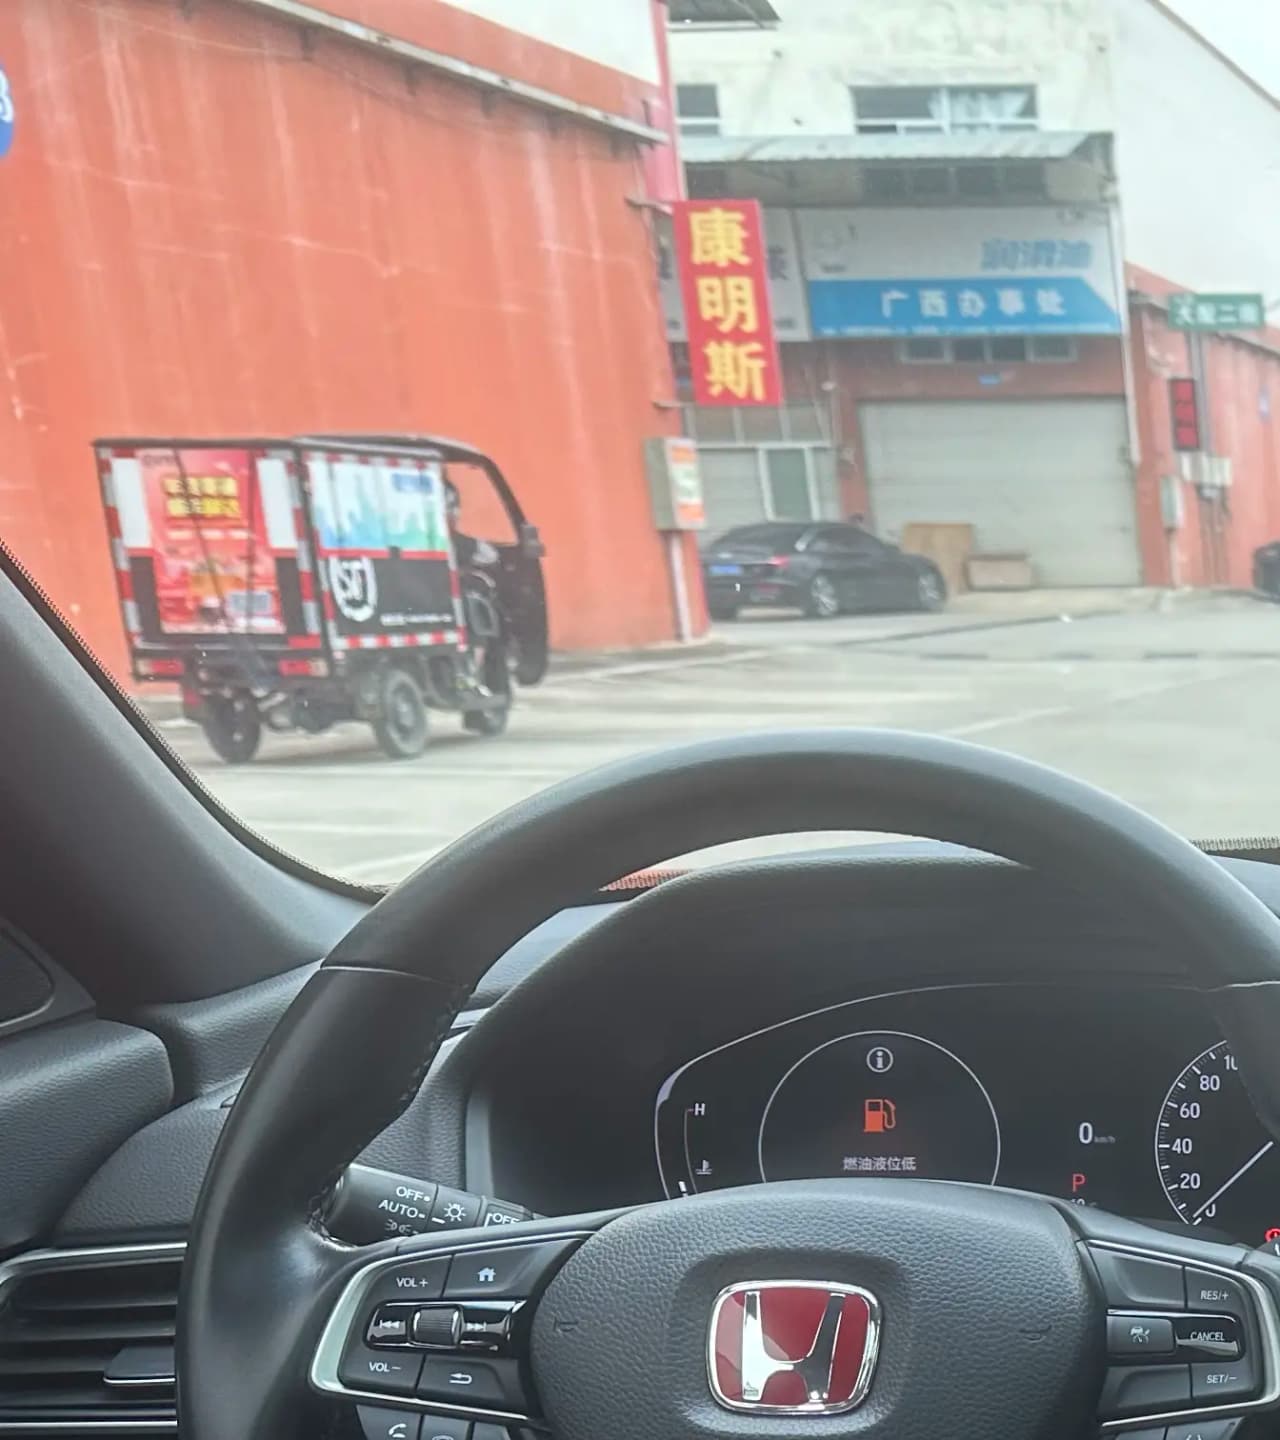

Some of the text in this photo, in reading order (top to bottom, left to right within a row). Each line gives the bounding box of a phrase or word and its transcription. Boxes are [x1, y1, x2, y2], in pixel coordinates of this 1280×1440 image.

[688, 207, 767, 401] 康明斯
[881, 288, 1066, 318] 广西办事处
[1200, 1075, 1220, 1091] 80
[694, 1102, 706, 1116] H
[1179, 1102, 1201, 1118] 60
[1078, 1122, 1093, 1144] 0
[1172, 1138, 1193, 1154] 40
[843, 1156, 917, 1172] 燃油液位低
[1072, 1173, 1086, 1192] P
[1179, 1173, 1201, 1189] 20
[396, 1186, 424, 1202] OFF
[378, 1199, 419, 1218] AUTO
[1190, 1331, 1225, 1341] CANCEL
